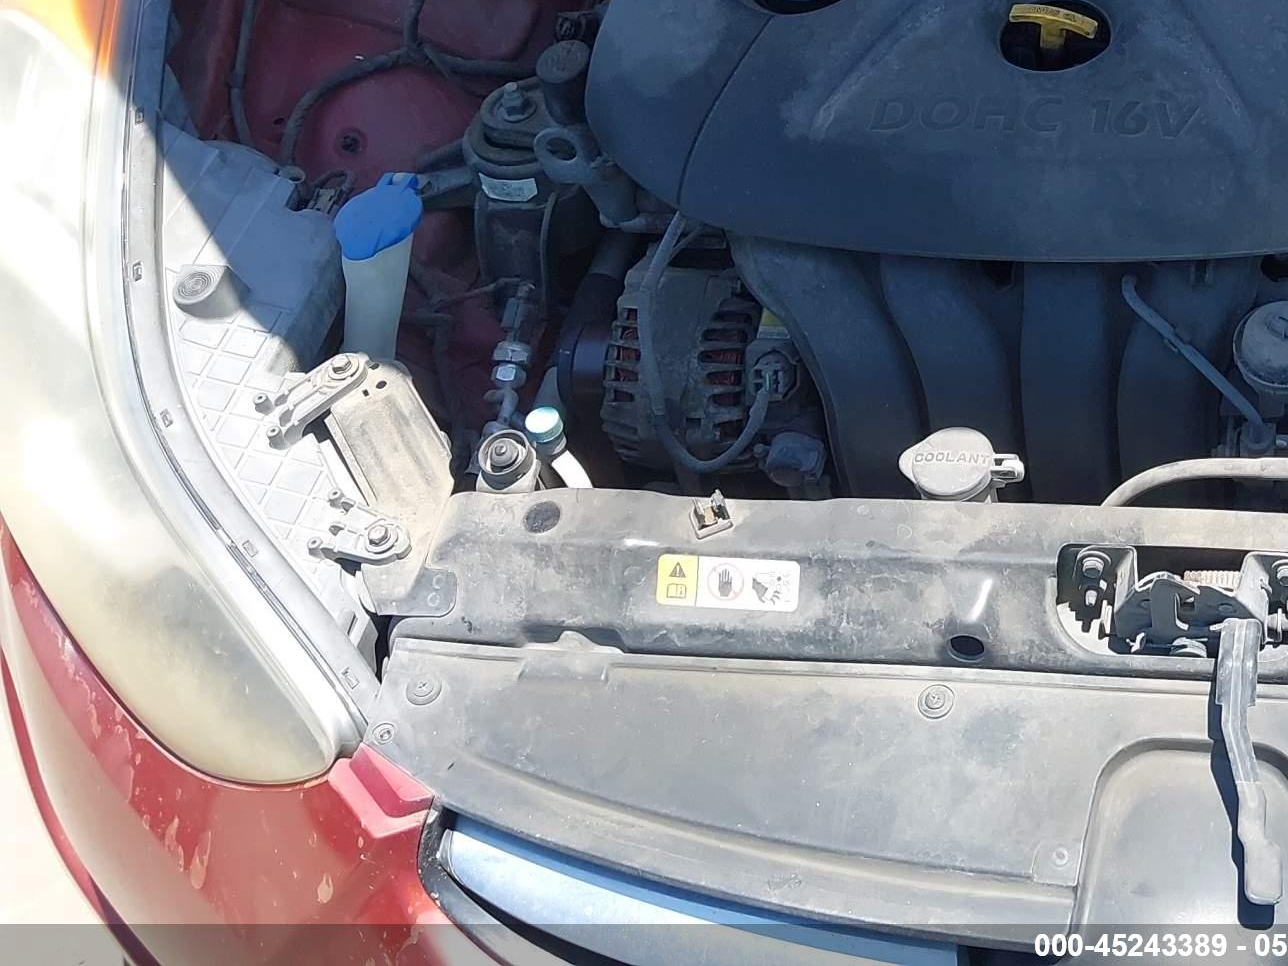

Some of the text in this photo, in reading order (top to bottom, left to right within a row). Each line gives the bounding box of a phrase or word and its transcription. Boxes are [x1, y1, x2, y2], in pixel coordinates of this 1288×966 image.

[869, 96, 1200, 139] DOHC 16V
[914, 452, 990, 464] COOLANT
